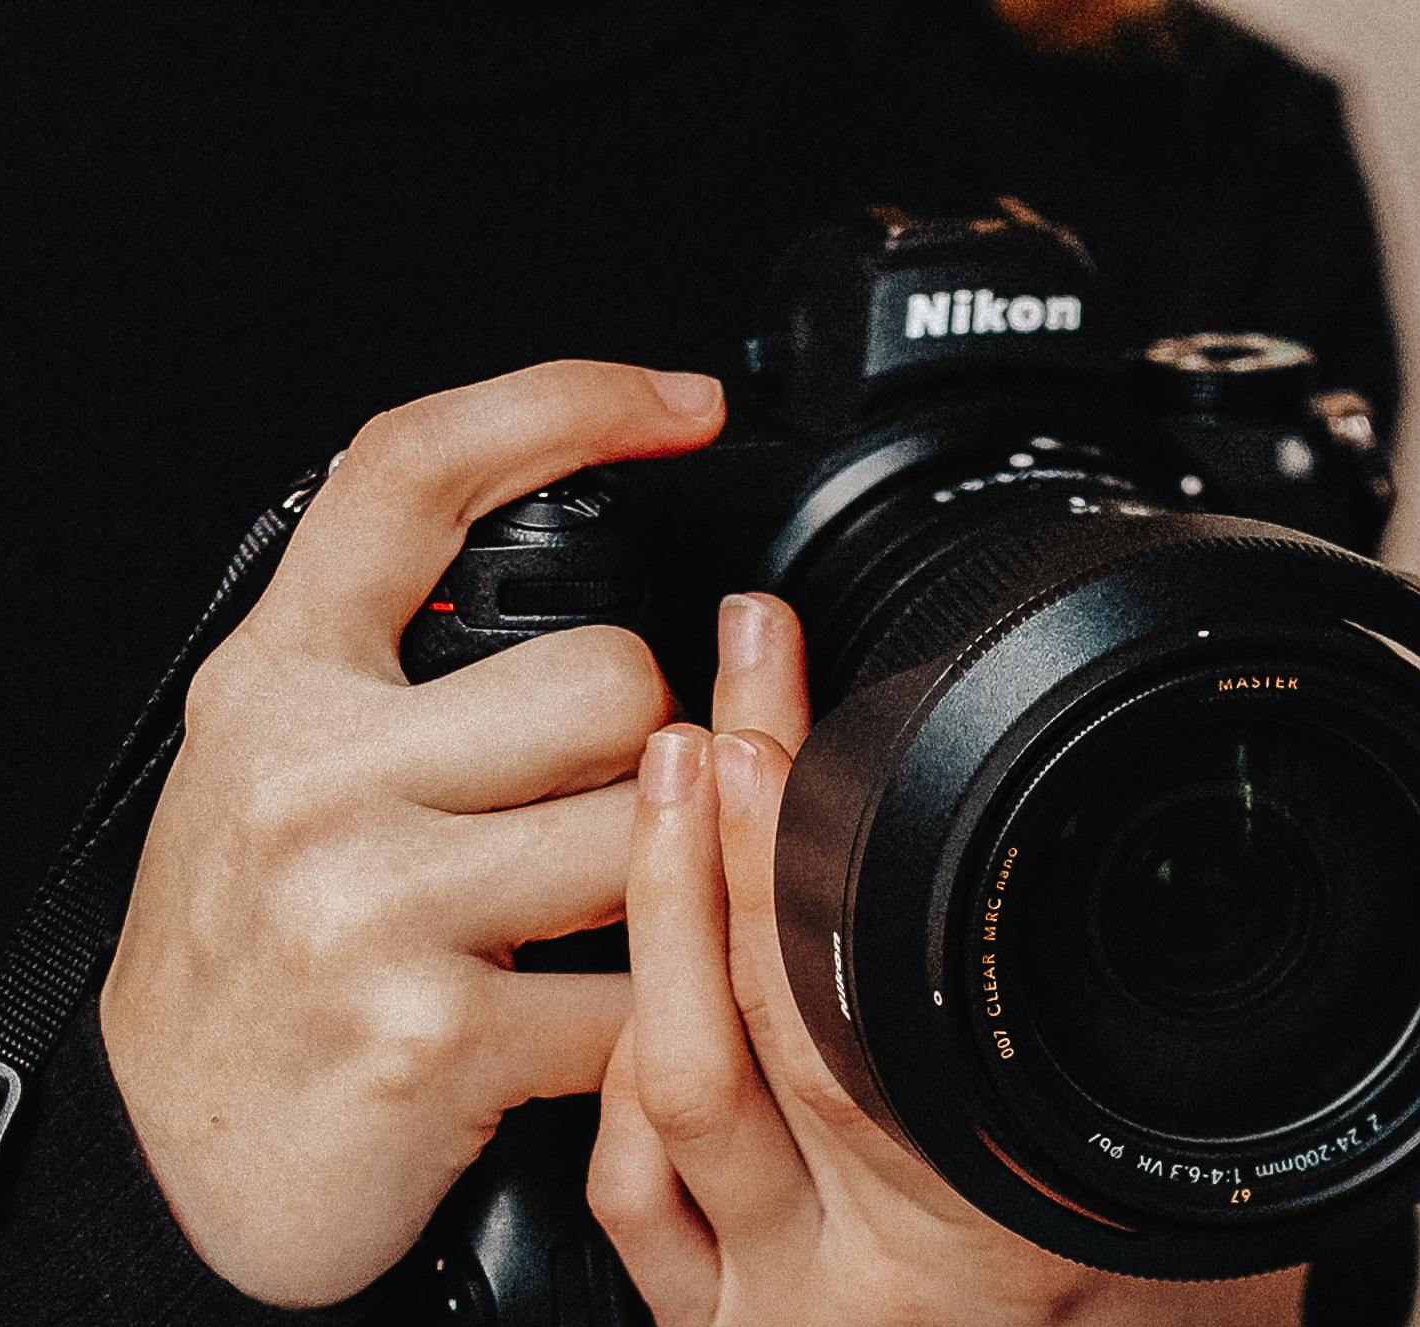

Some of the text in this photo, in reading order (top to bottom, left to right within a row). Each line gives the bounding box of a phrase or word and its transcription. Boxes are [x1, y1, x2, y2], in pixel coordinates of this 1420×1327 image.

[905, 288, 1082, 339] Nikon
[1217, 675, 1299, 691] MASTER
[982, 847, 1018, 1060] 007 CLEAR MRC nano
[1254, 1126, 1363, 1178] 24-200mm
[1230, 1188, 1253, 1205] 67
